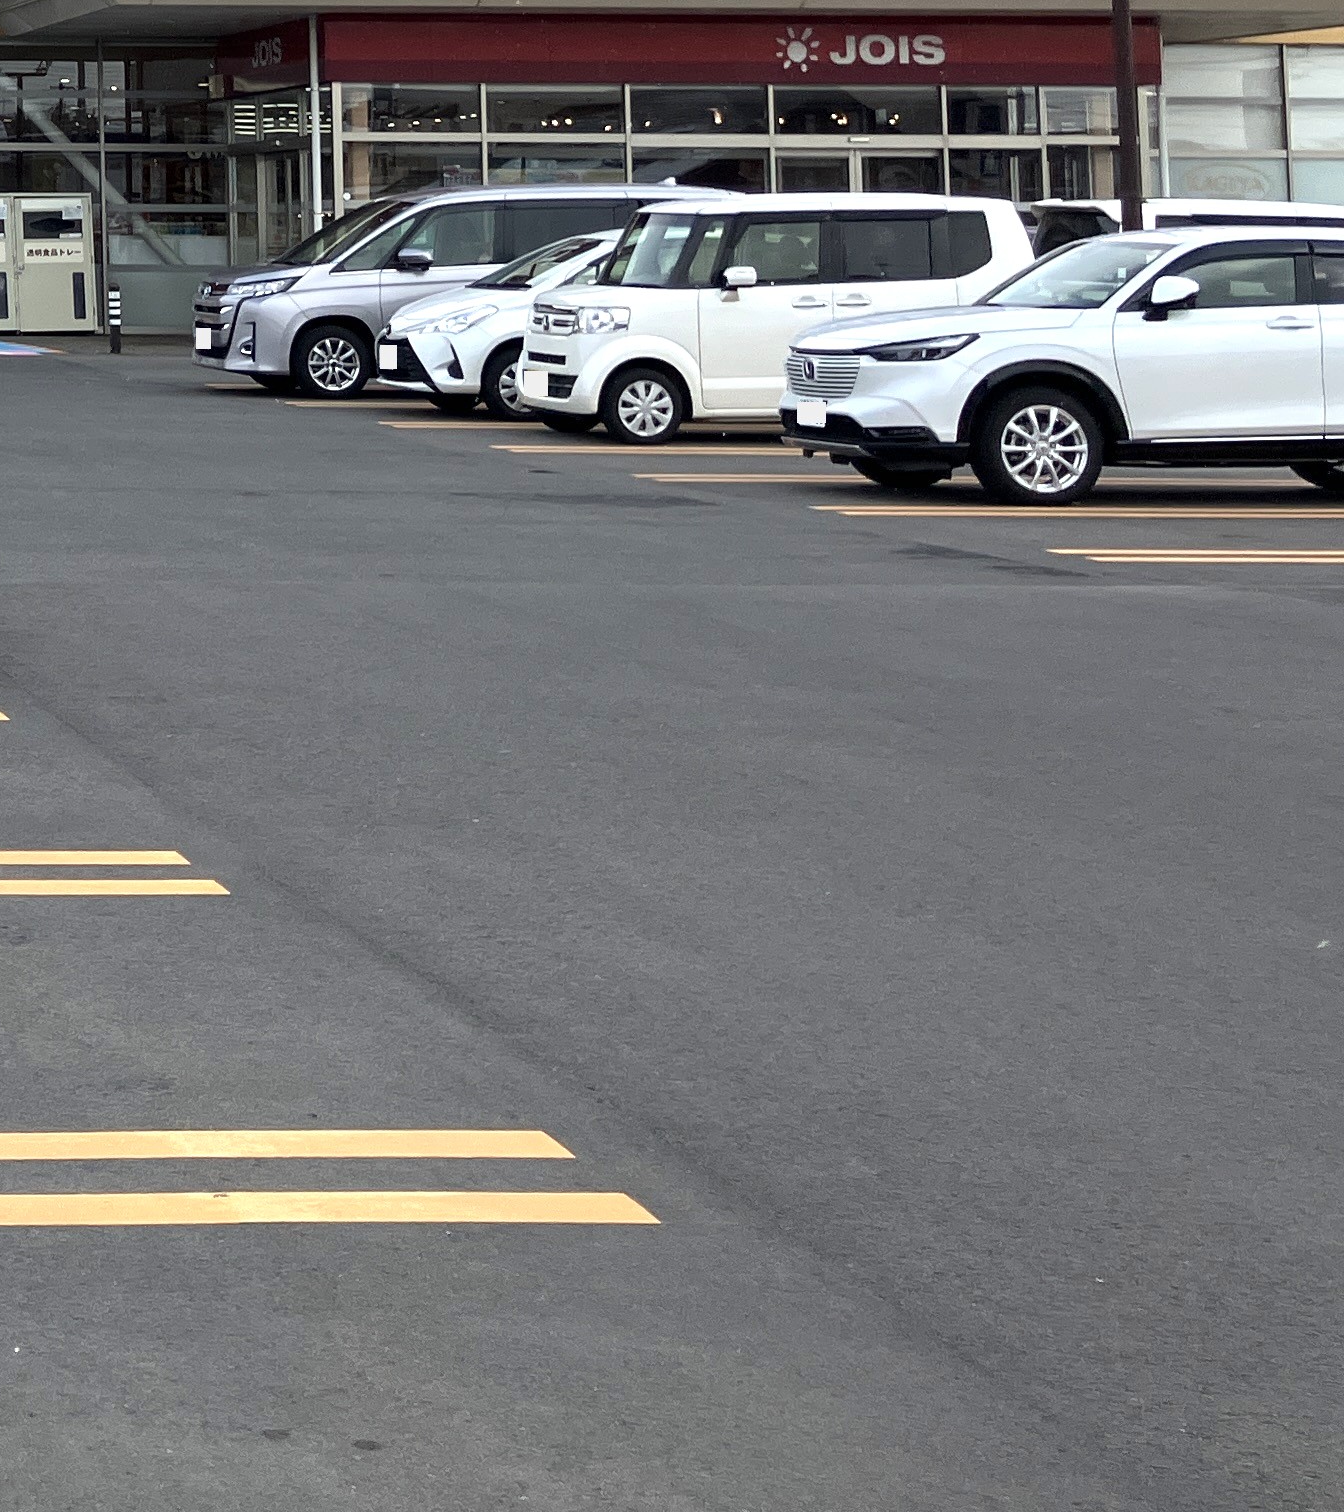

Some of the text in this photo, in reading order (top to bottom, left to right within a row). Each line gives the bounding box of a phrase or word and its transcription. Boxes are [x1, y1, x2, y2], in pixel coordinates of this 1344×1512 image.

[252, 37, 282, 68] JOIS
[829, 34, 946, 65] JOIS
[26, 248, 81, 257] 透明食品トレー
